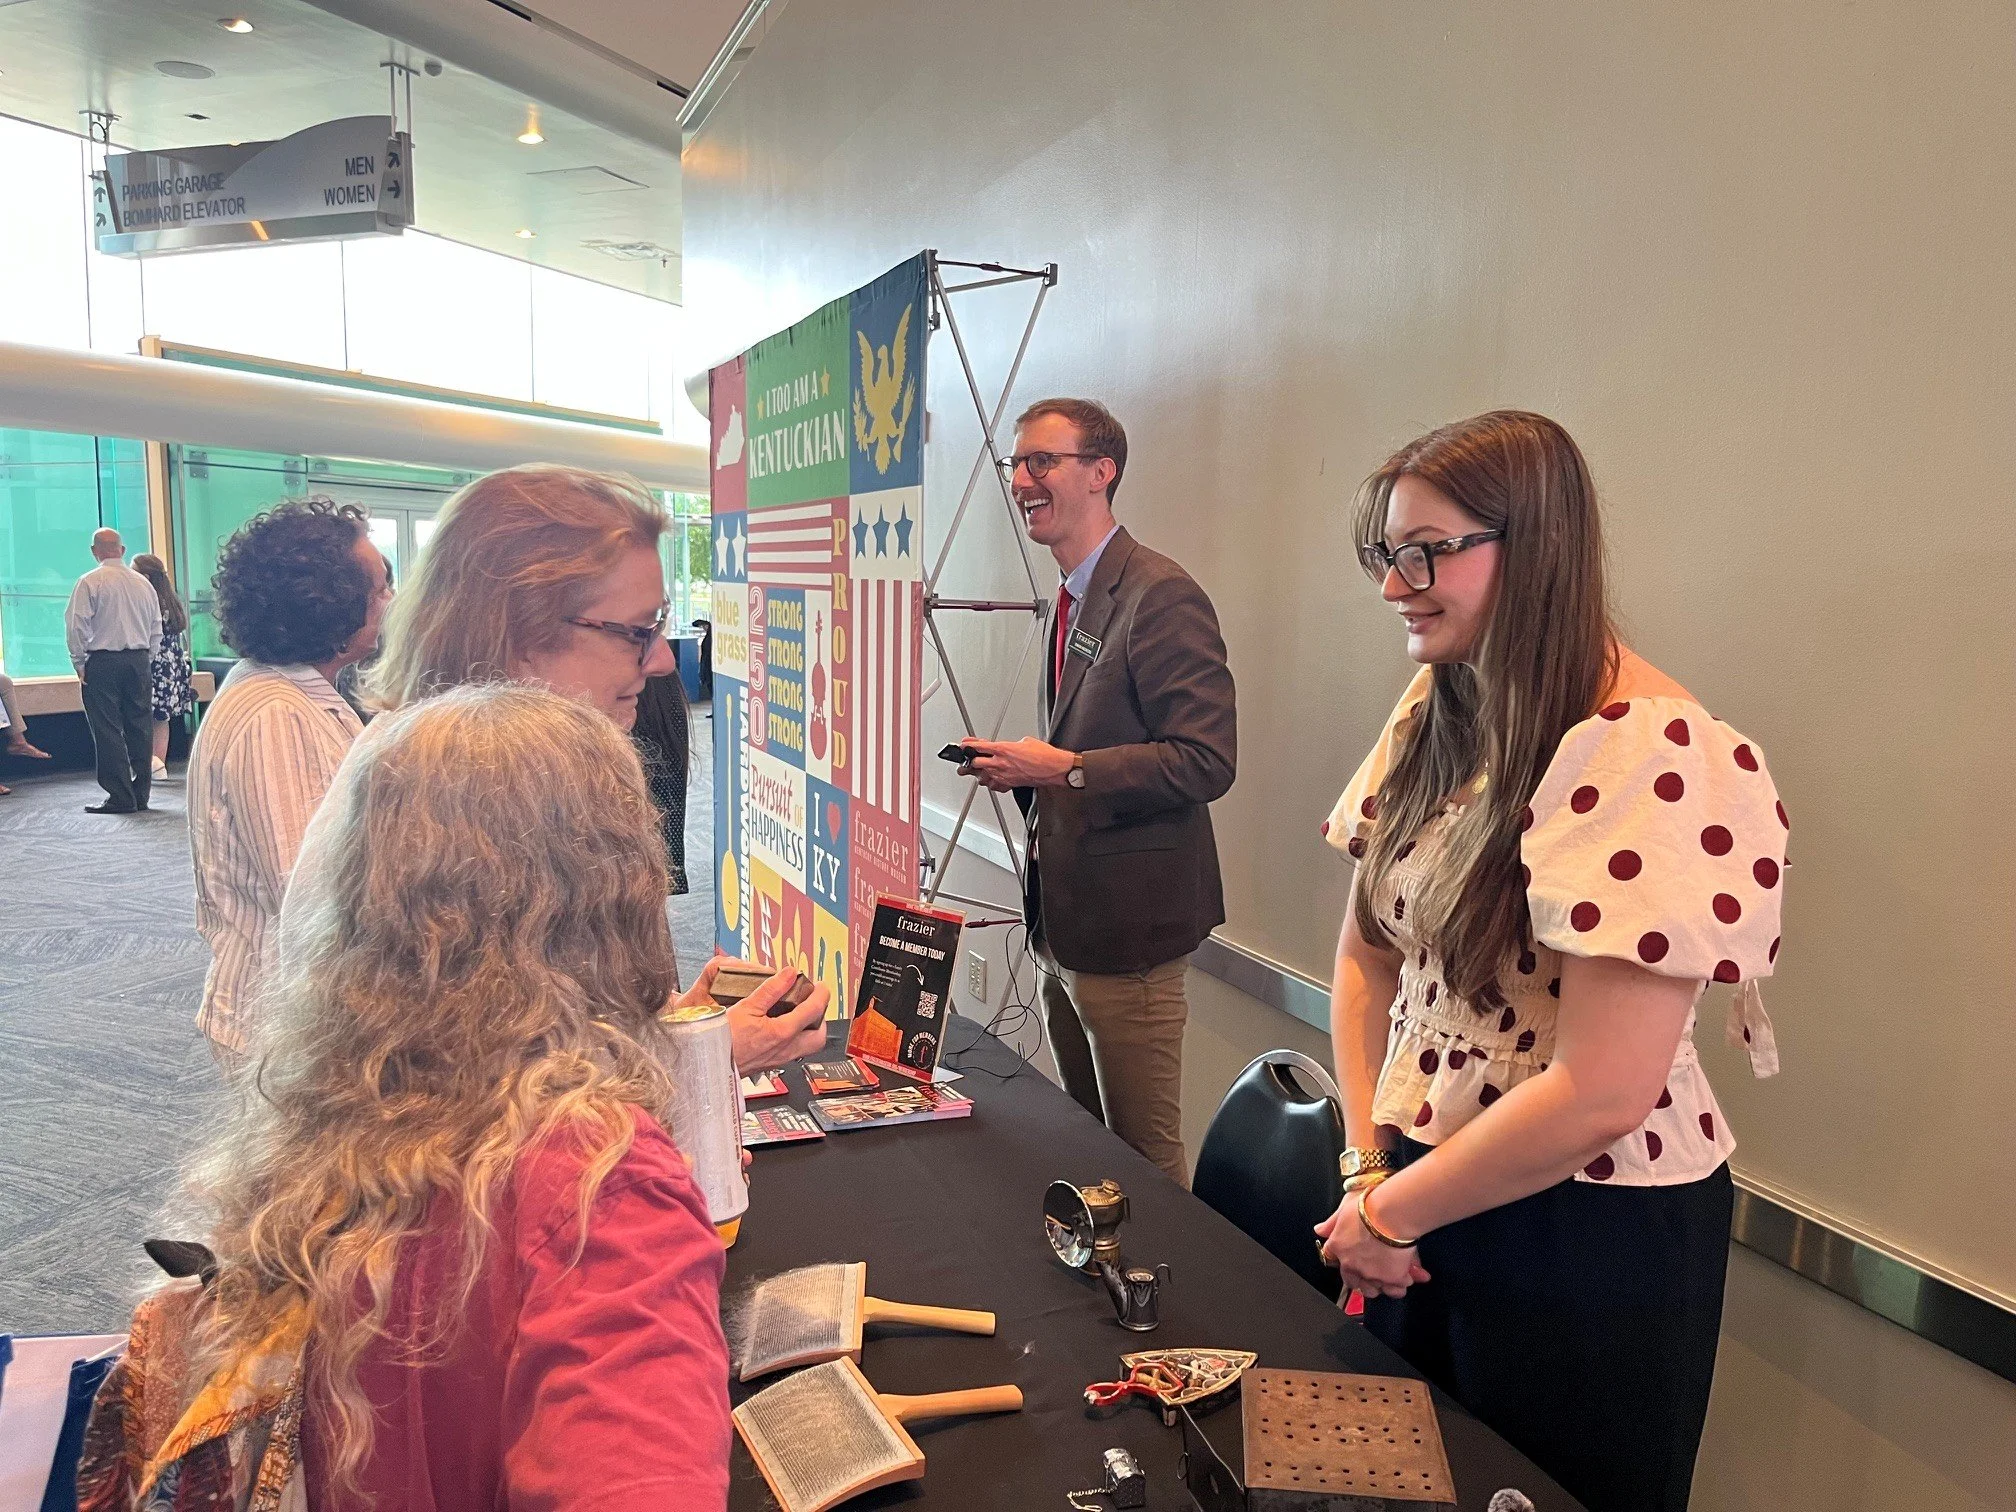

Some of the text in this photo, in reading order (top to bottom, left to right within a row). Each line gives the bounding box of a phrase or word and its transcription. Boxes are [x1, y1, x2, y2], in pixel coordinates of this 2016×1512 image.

[345, 156, 375, 177] MEN
[122, 172, 225, 202] PARKING GARAGE
[324, 185, 375, 206] WOMEN
[123, 197, 246, 227] BOMHARD ELEVATOR
[766, 370, 819, 418] I TOO AM A
[749, 408, 845, 479] KENTUCKIAN
[716, 590, 739, 627] blue
[767, 598, 803, 632] STRONG
[716, 630, 747, 665] grass
[767, 637, 803, 672] STRONG
[832, 518, 848, 770] PROUD
[749, 585, 765, 746] 250
[768, 675, 804, 713] STRONG
[768, 712, 804, 752] STRONG
[751, 764, 804, 829] Pursuit OF
[813, 792, 820, 838] I
[751, 806, 804, 872] HAPPINESS
[854, 810, 909, 872] frazier
[812, 843, 841, 903] KY
[896, 915, 936, 938] frazier
[879, 935, 901, 950] BECOME
[900, 940, 905, 951] A
[904, 941, 928, 957] MEMBER
[928, 946, 946, 962] TODAY
